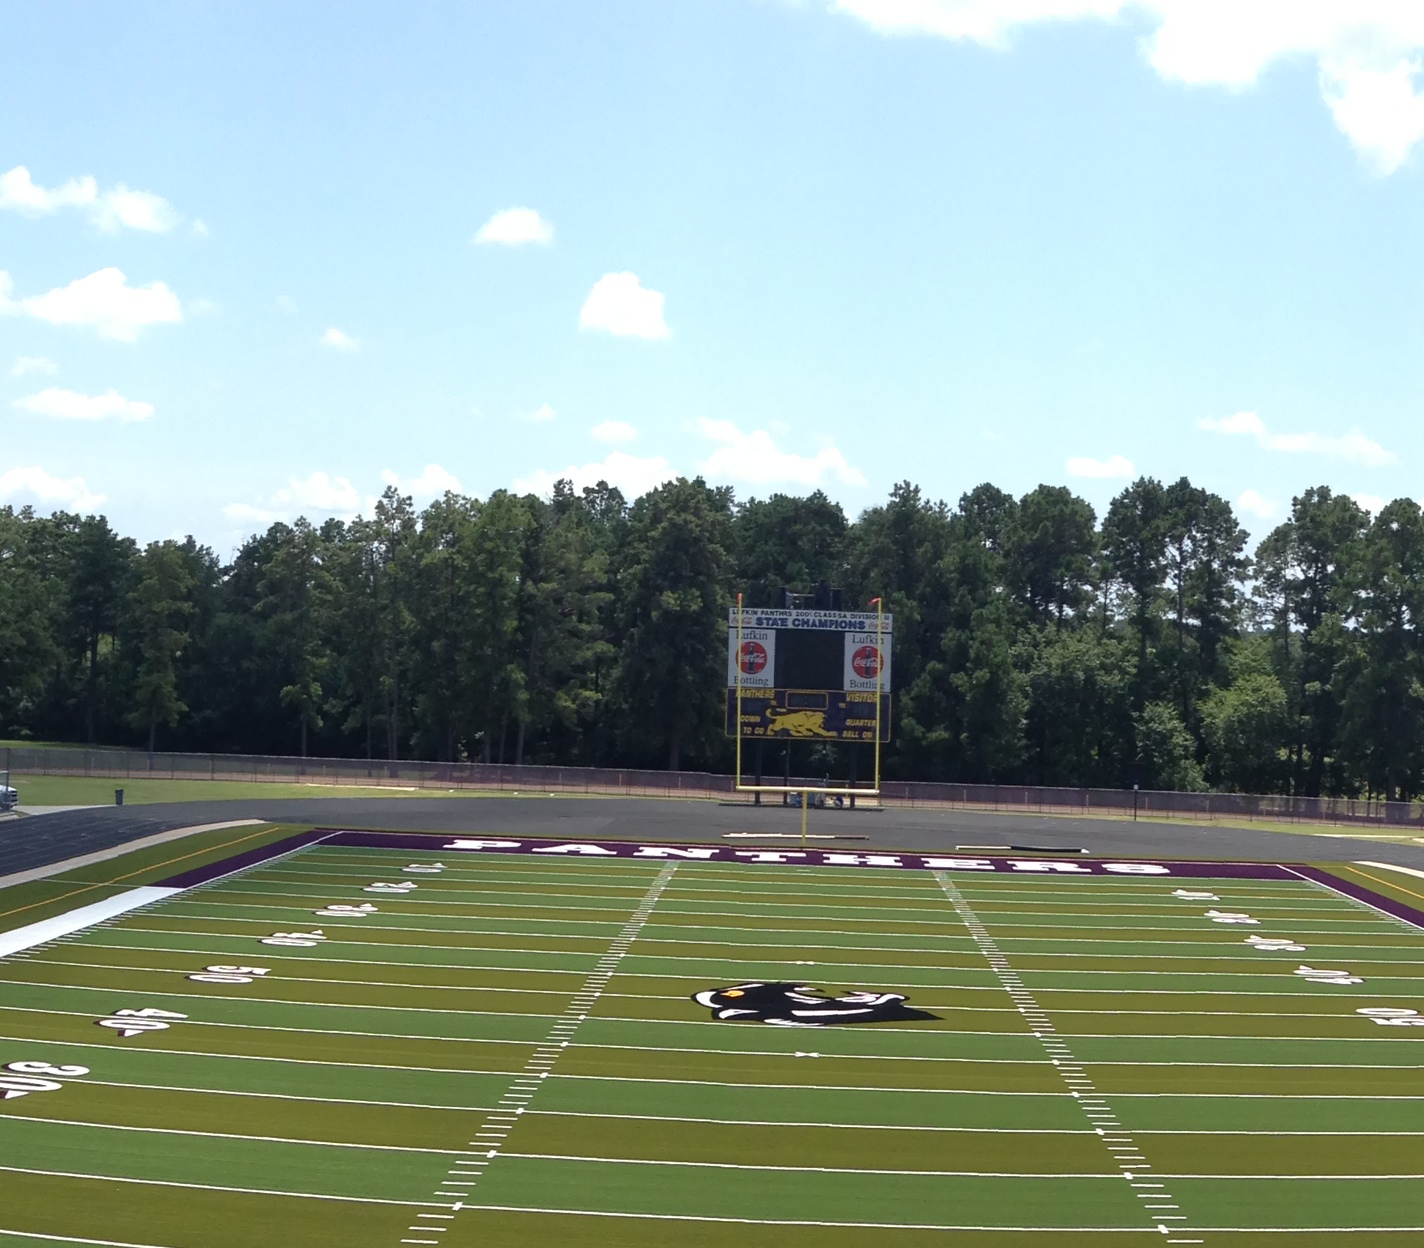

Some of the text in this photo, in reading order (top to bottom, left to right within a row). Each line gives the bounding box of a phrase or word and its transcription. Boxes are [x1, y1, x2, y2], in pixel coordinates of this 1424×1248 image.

[792, 617, 865, 631] CHAMPIONS
[736, 629, 767, 640] Lufkin
[852, 634, 884, 645] Lufkin
[734, 675, 768, 687] Bottling
[849, 679, 886, 690] Bottling
[845, 718, 877, 727] QUARTER
[743, 726, 752, 734] TO
[443, 839, 1171, 875] PANTHERS
